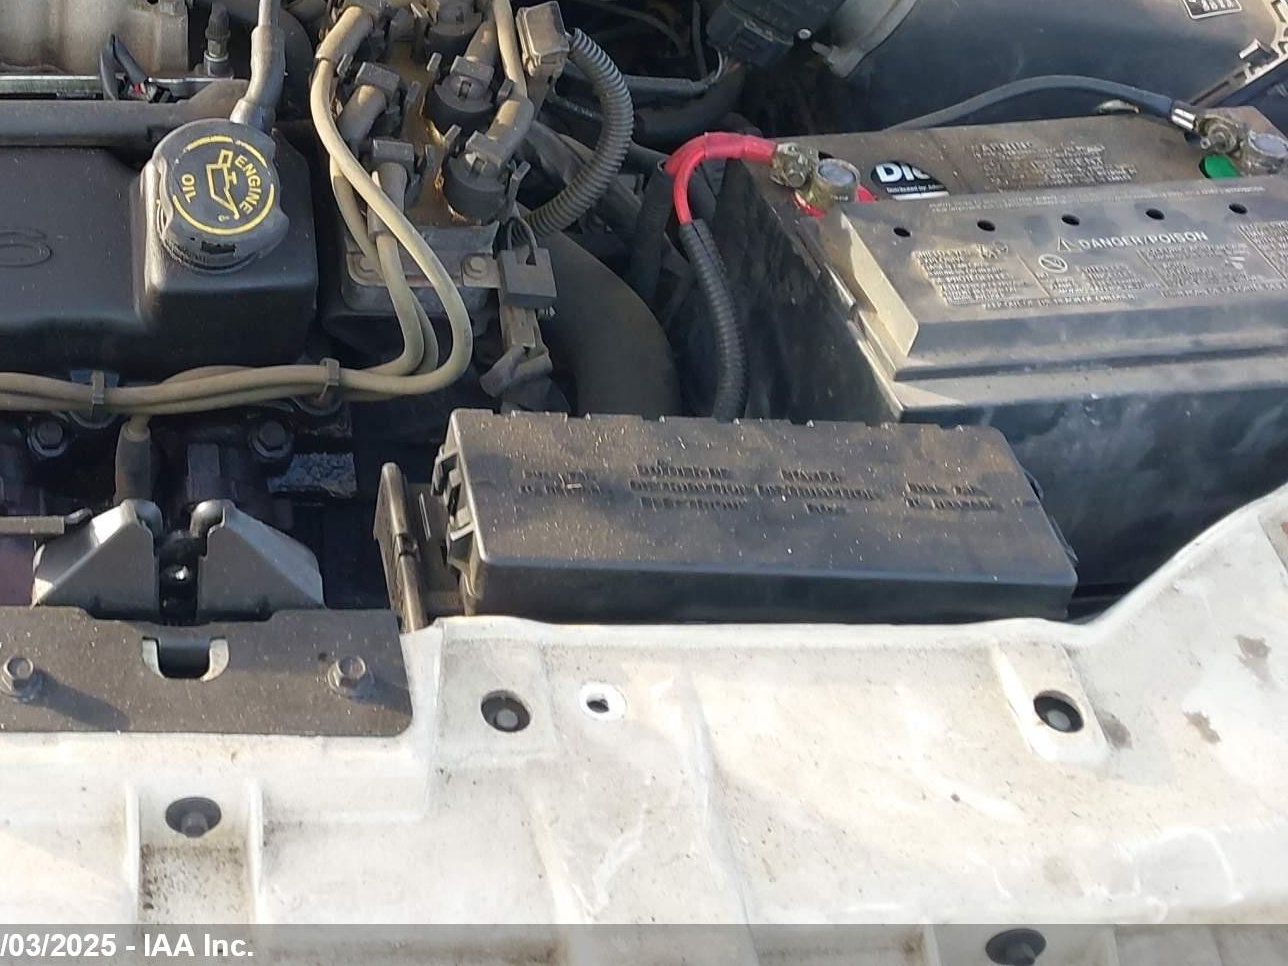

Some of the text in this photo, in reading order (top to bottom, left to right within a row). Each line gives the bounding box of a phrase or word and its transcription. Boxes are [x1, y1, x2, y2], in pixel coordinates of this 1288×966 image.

[181, 174, 197, 204] OIL
[234, 154, 262, 215] ENGINE
[1078, 230, 1209, 251] DANGER/POISON
